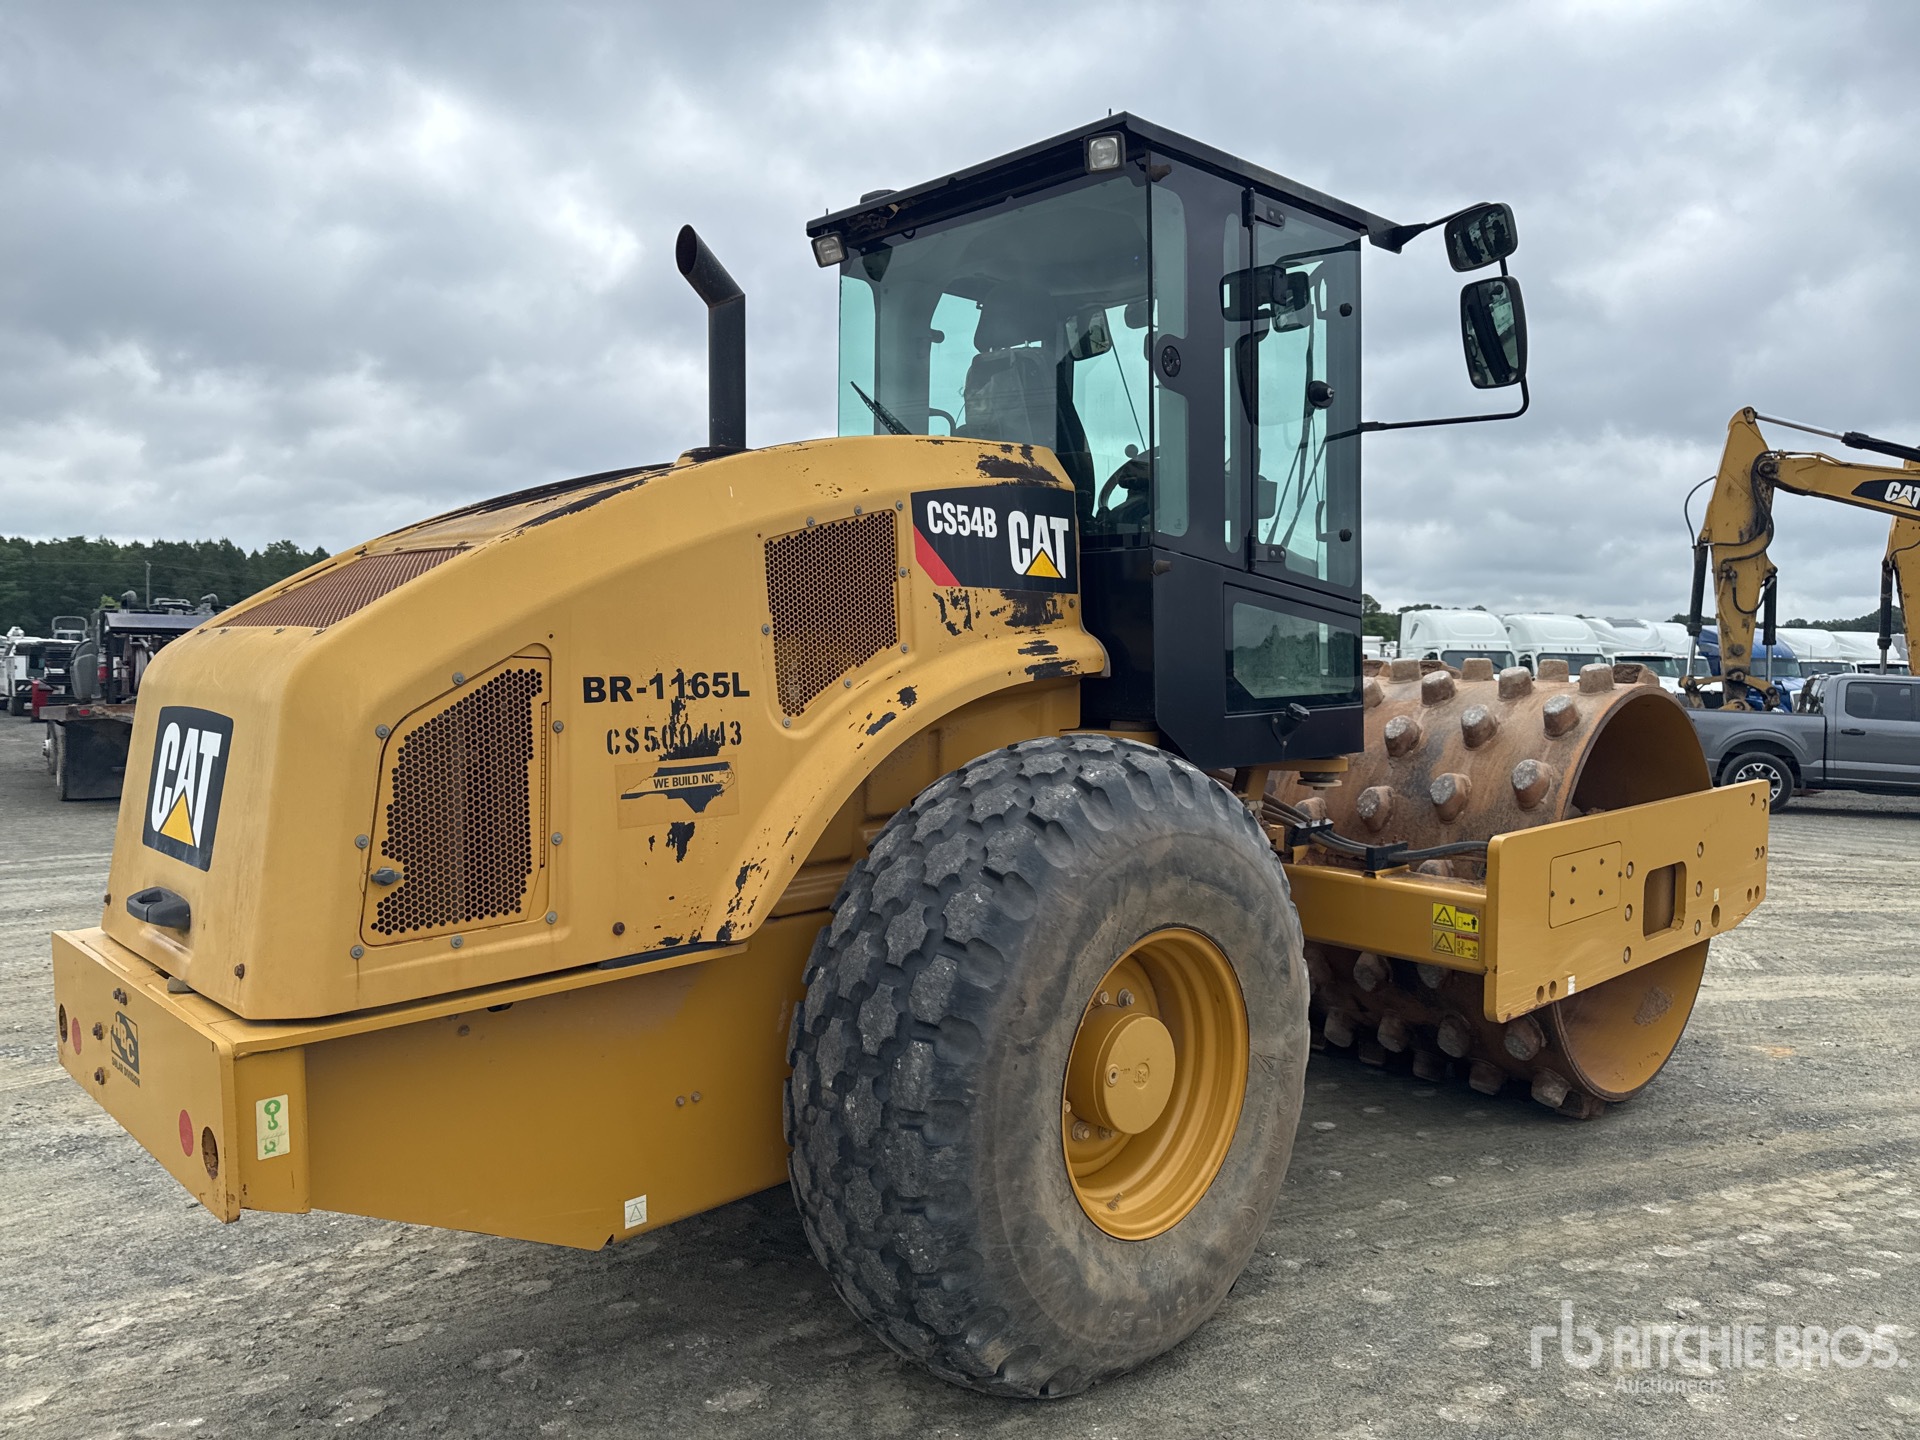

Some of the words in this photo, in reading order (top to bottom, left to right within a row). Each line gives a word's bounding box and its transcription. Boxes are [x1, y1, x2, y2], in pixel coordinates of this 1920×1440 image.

[1884, 481, 1920, 508] CAT
[926, 500, 998, 538] CS54B
[1007, 510, 1069, 579] CAT
[582, 672, 750, 703] BR-1165L
[151, 722, 222, 848] CAT
[653, 778, 669, 789] WE
[672, 775, 699, 787] BUILD
[701, 773, 714, 784] NC
